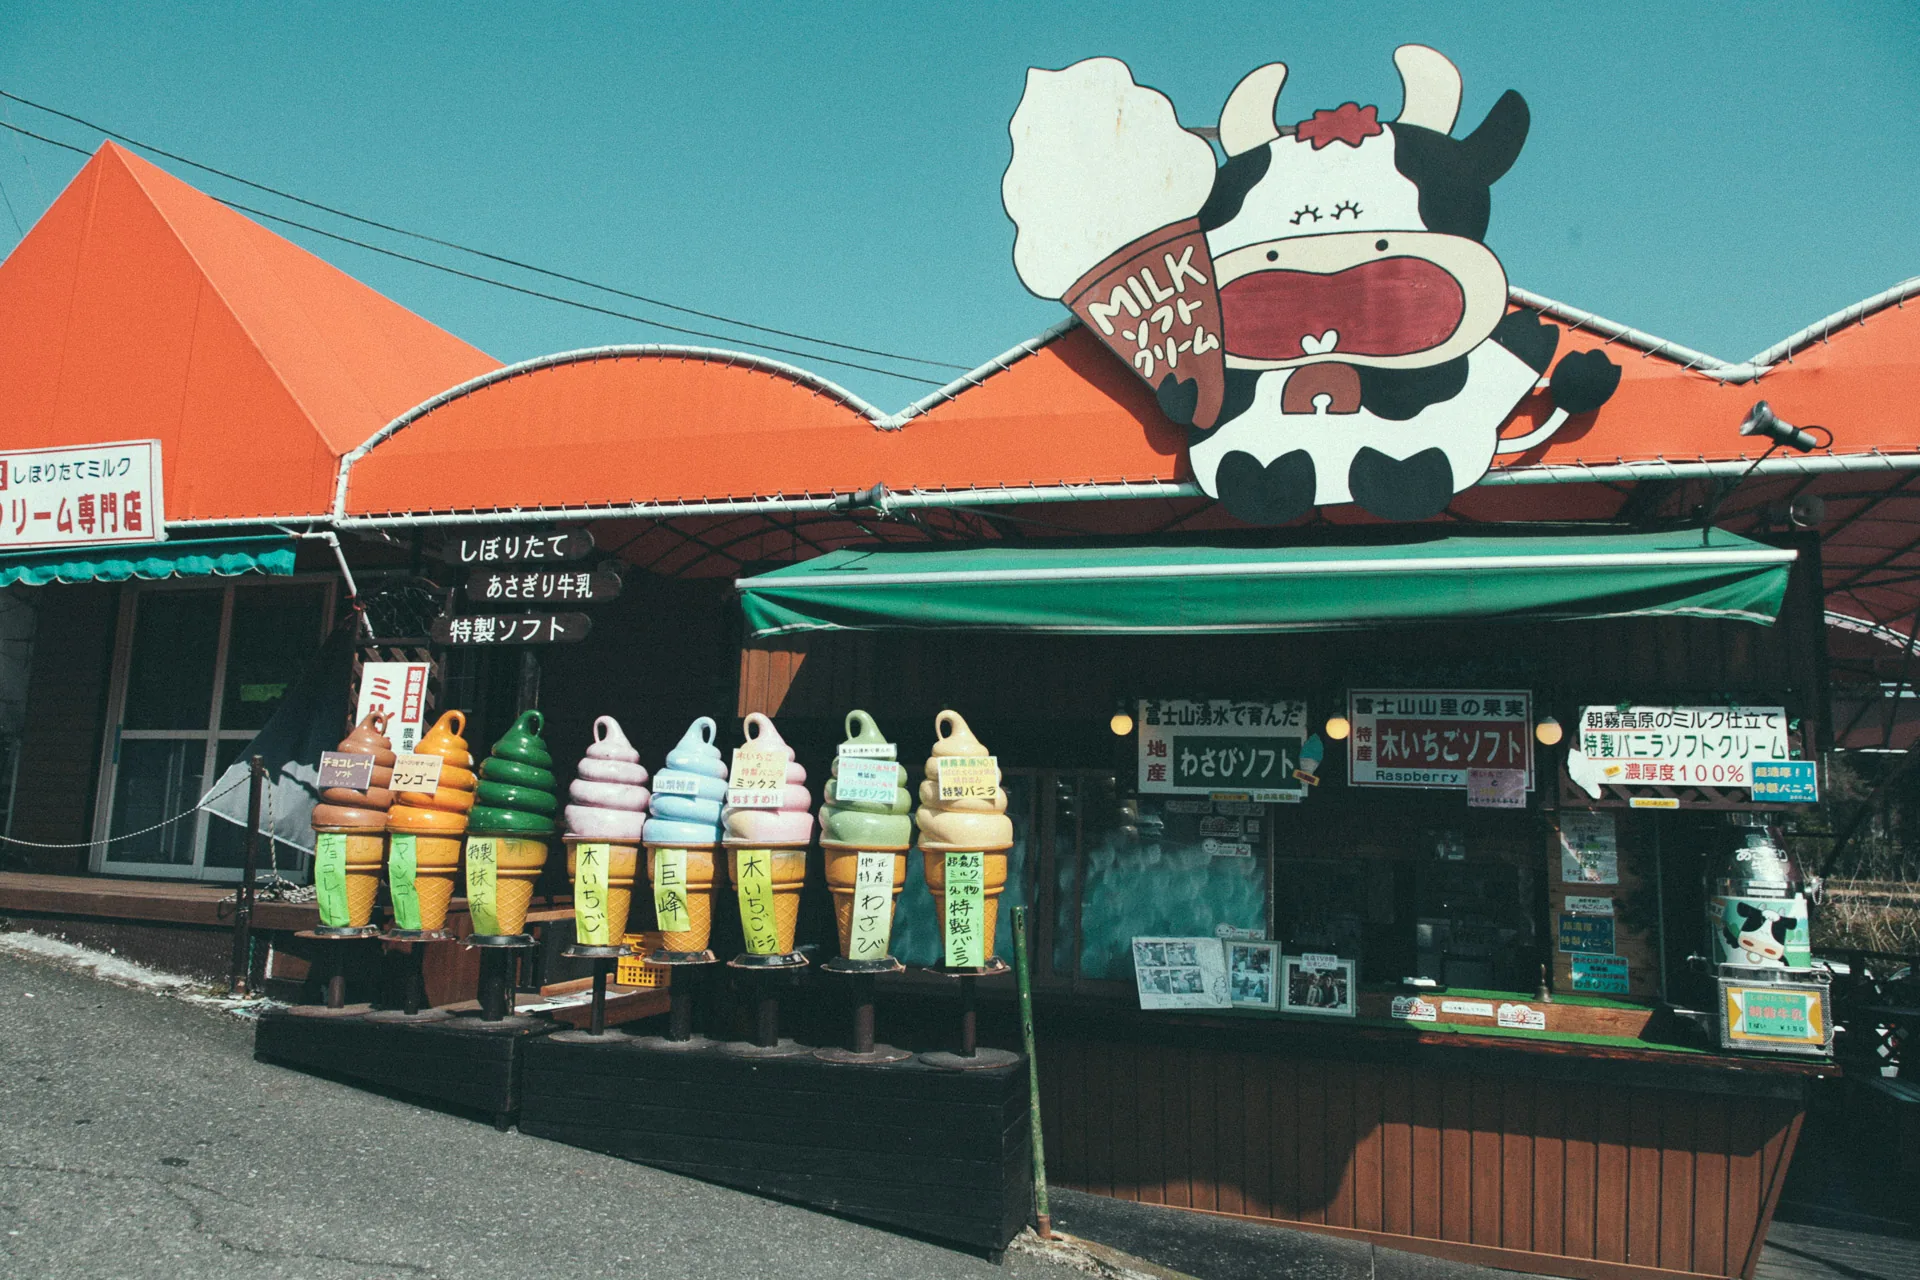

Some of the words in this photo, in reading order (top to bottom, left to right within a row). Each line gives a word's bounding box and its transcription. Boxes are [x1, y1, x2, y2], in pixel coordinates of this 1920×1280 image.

[1087, 245, 1208, 336] MILK
[1121, 297, 1203, 350] ソフト
[1133, 325, 1220, 378] クリーム
[0, 490, 142, 536] リーム専門店
[461, 534, 568, 562] しぼりたて
[486, 573, 593, 598] あさぎり牛乳
[450, 616, 565, 643] 特製ソフト
[1145, 701, 1303, 727] 富士山湧水で育んだ
[1356, 697, 1525, 718] 富士山山里の果実
[1586, 711, 1778, 730] 朝霧高原のミルク仕立て
[1146, 739, 1168, 782] 地産
[1356, 726, 1374, 762] 特産
[1381, 728, 1521, 764] 木いちごソフト
[1584, 733, 1786, 760] 特製バニラソフトクリーム
[322, 756, 371, 769] チョコレート
[393, 772, 437, 786] マンゴー
[1180, 747, 1294, 779] わさびソフト
[1376, 770, 1459, 783] Raspberry
[736, 777, 777, 789] ミックス
[942, 785, 996, 797] 特製バニラ
[321, 838, 343, 926] チョコレート
[395, 842, 416, 920] マンゴー
[581, 847, 606, 933] 木いちご
[658, 863, 683, 922] 巨峰
[742, 856, 770, 932] 木いちご
[857, 894, 885, 954] わさび
[948, 898, 974, 967] 特製バニラ
